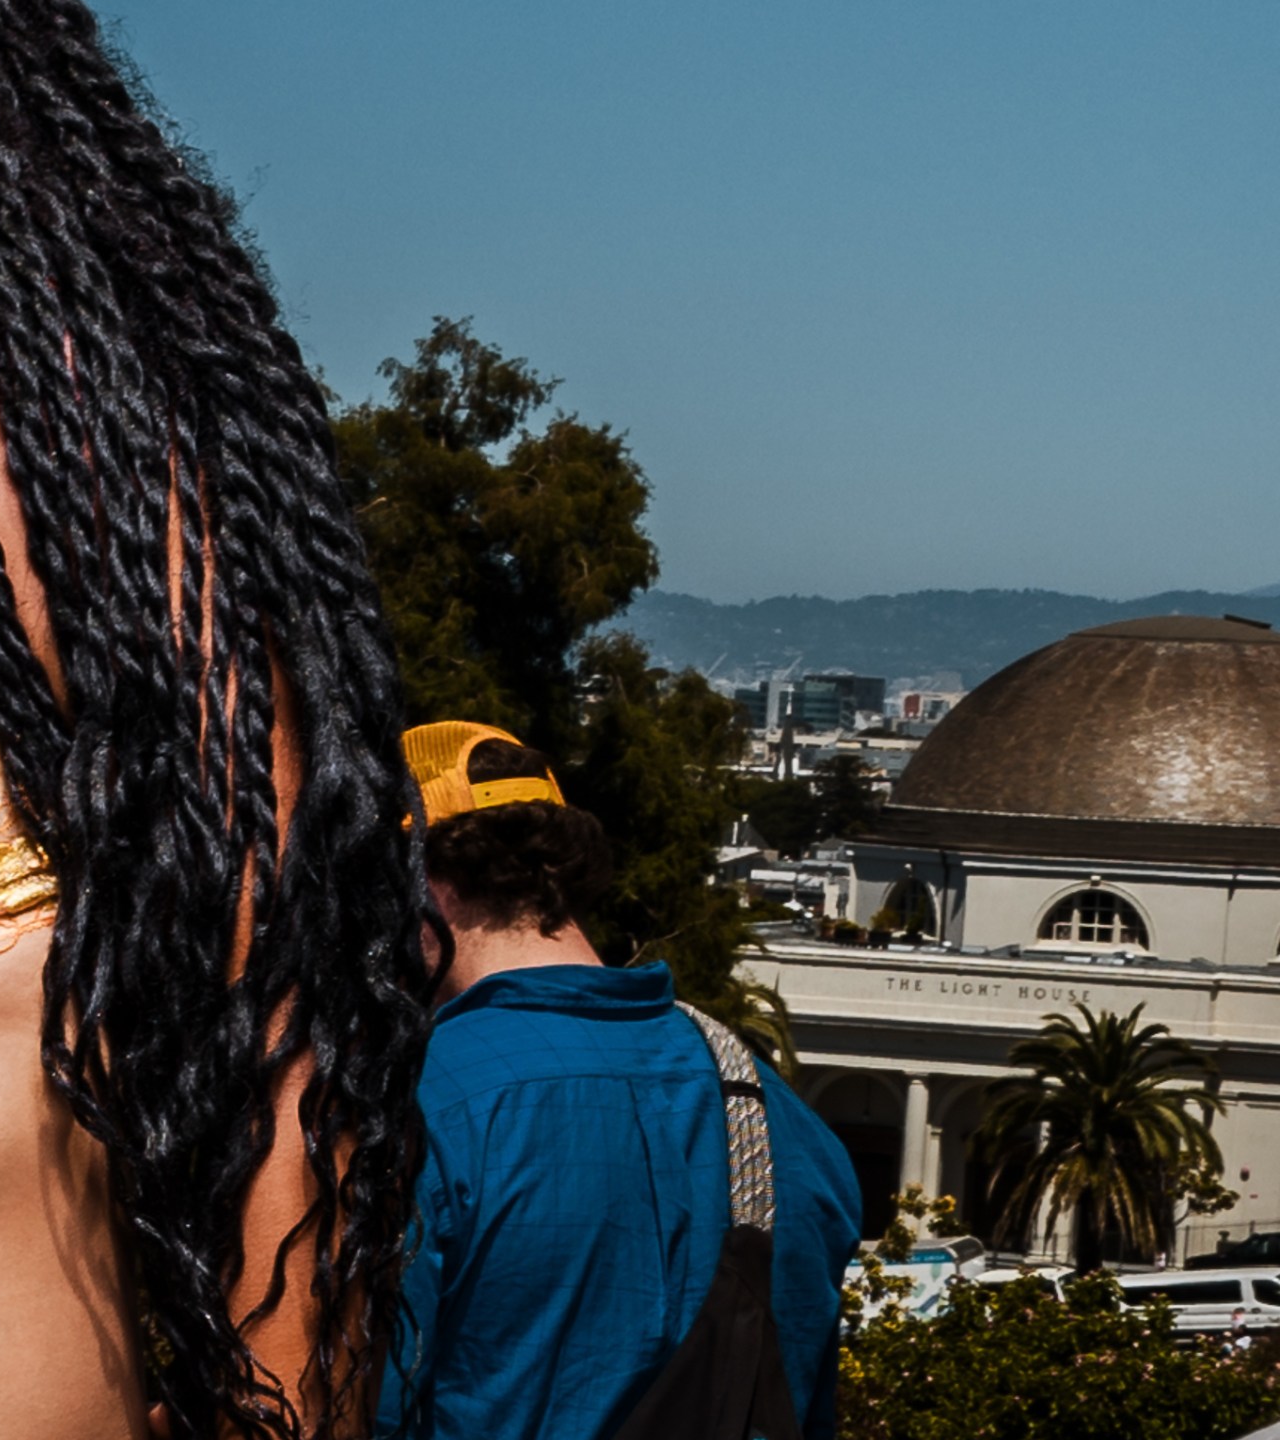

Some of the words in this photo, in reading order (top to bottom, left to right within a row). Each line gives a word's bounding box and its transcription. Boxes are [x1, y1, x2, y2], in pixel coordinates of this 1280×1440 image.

[886, 978, 922, 992] THE
[940, 981, 1002, 997] LIGHT
[1018, 986, 1091, 1002] HOUSE
